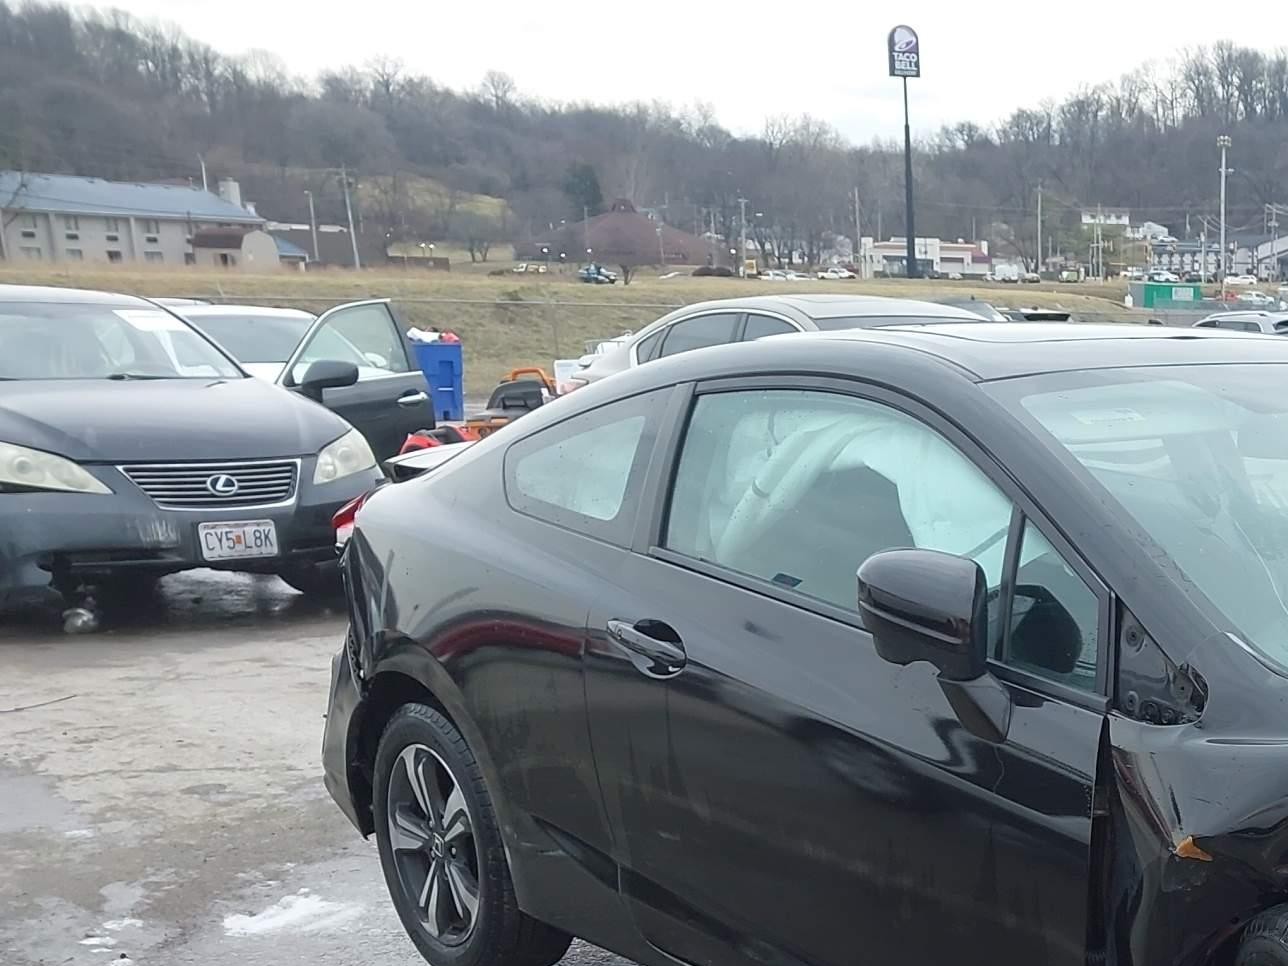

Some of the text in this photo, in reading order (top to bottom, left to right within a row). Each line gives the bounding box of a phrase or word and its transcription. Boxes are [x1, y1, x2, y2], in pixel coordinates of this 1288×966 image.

[892, 52, 918, 62] TACO
[895, 60, 918, 70] BELL
[204, 528, 273, 551] CY5 L8K
